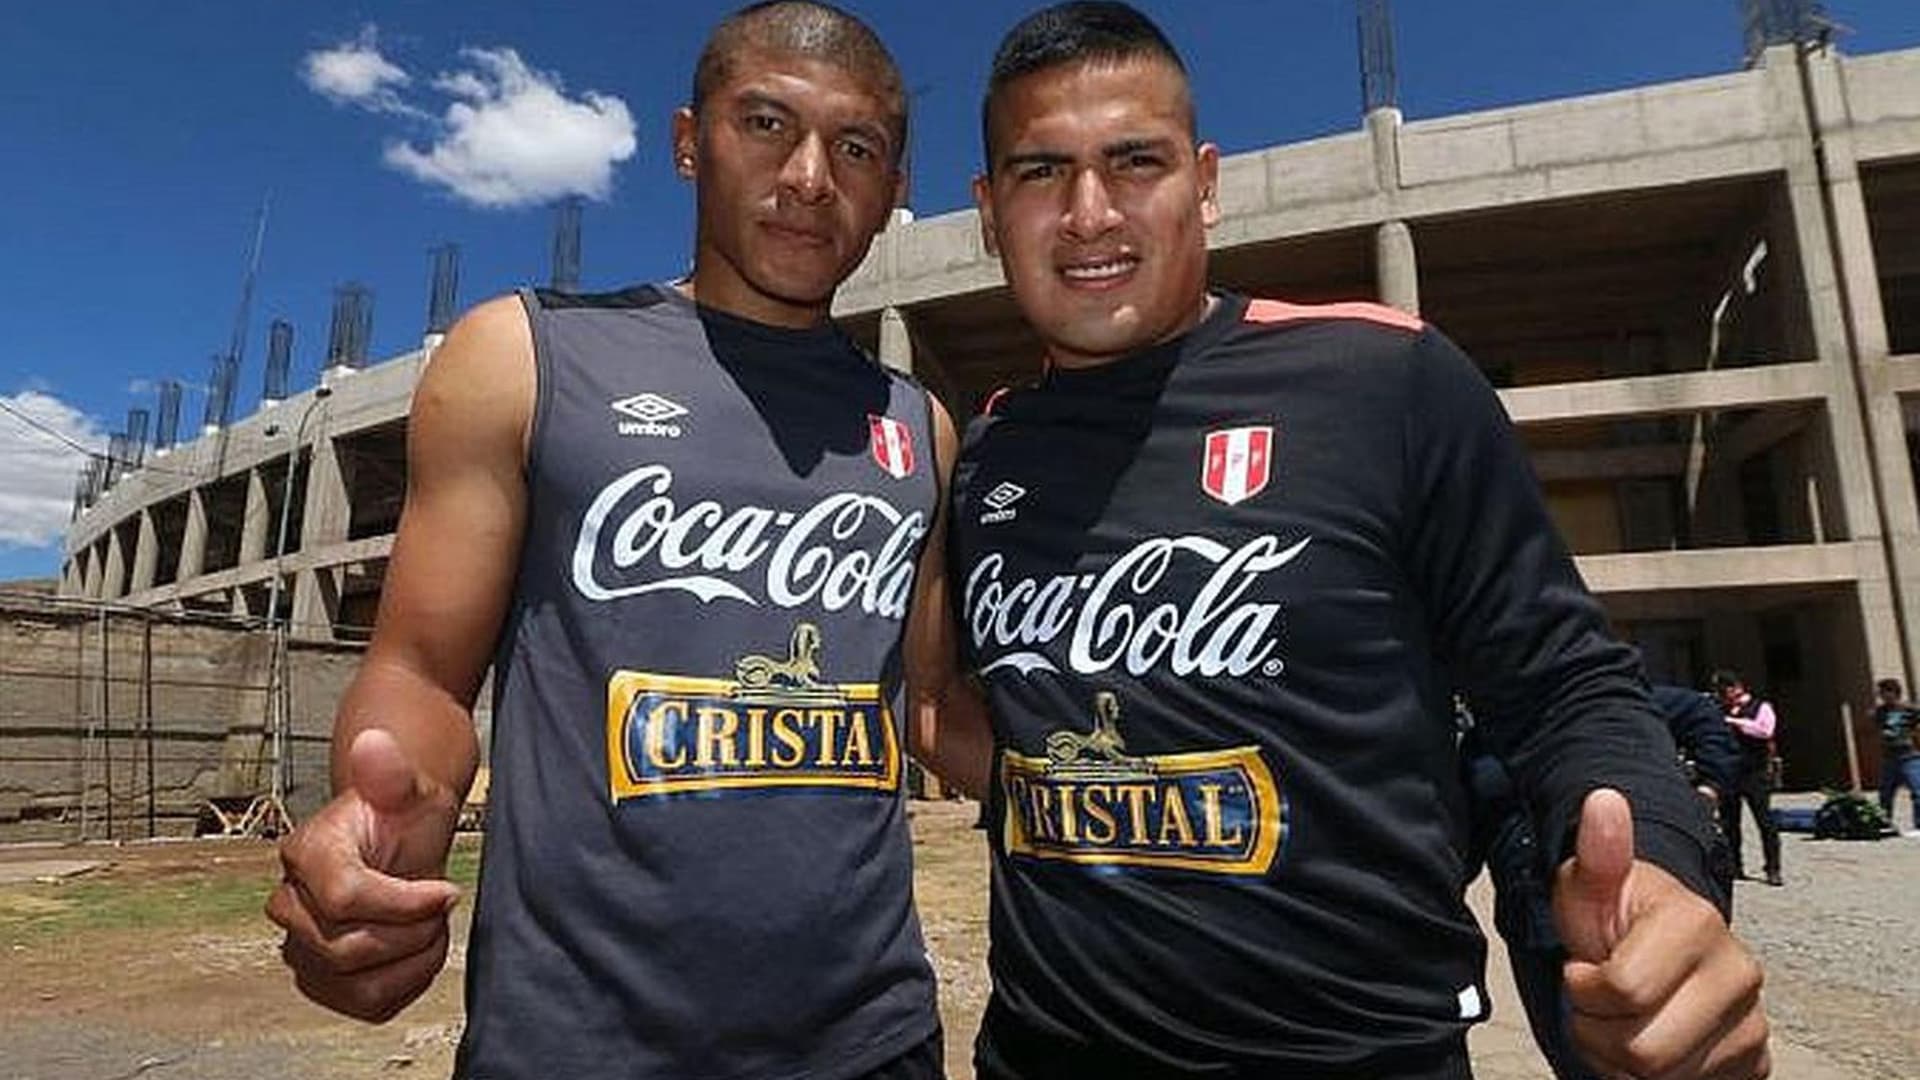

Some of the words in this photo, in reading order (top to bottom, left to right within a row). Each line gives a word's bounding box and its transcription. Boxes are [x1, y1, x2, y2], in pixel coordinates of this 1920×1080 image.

[619, 421, 680, 437] umbro
[573, 465, 926, 619] Coca-Cola
[645, 701, 883, 768] CRISTA
